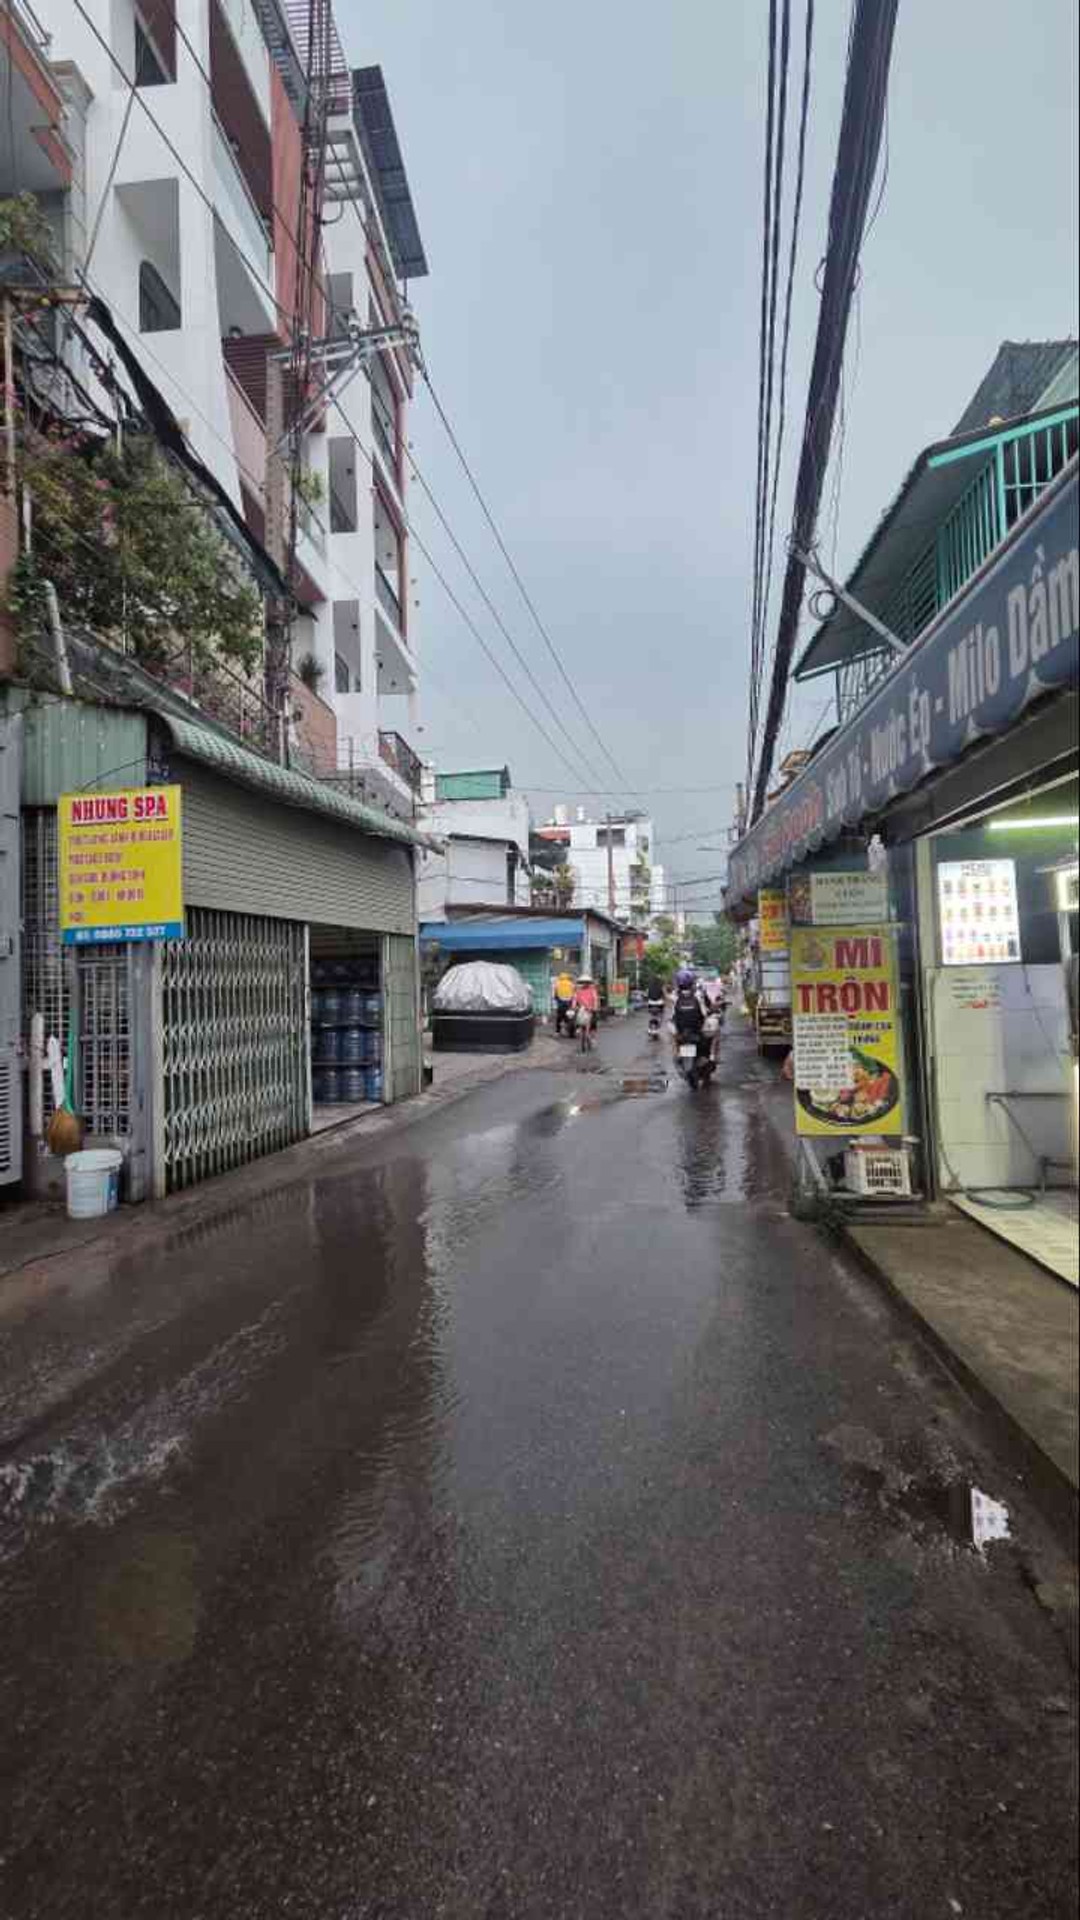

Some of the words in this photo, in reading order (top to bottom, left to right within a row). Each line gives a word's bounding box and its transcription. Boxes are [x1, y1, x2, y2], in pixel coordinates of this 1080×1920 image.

[948, 622, 1000, 725] Milo
[72, 798, 128, 822] NHUNG
[133, 794, 167, 818] SPA
[796, 975, 889, 1019] TRỘN
